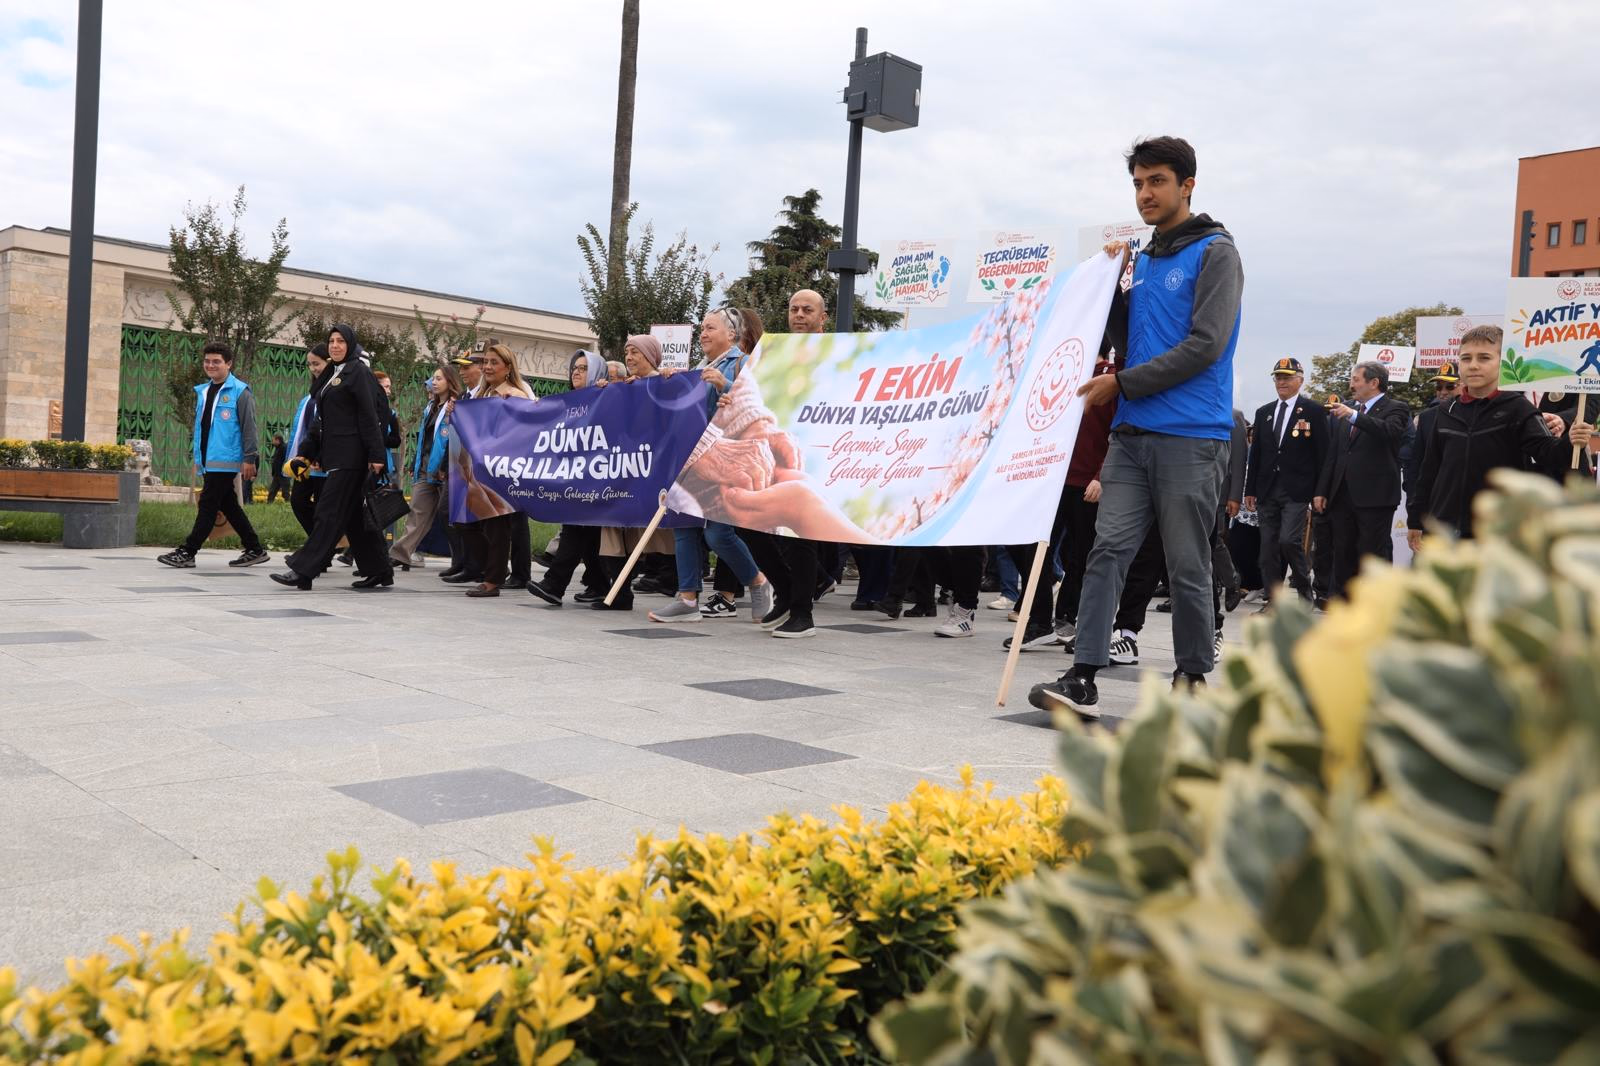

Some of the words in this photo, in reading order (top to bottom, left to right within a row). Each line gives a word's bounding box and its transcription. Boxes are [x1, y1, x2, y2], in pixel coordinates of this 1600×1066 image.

[892, 254, 913, 268] ADIM
[914, 250, 934, 262] ADIM
[983, 243, 1050, 265] TECRÜBEMİZ
[894, 262, 929, 278] SAĞLIĞA,
[977, 258, 1049, 279] DEĞERİMİZDİR!
[889, 276, 910, 288] ADIM
[910, 273, 929, 284] ADIM
[894, 282, 928, 298] HAYATA!
[1529, 302, 1587, 327] AKTİF
[1420, 348, 1451, 356] HUZUREVİ
[853, 367, 876, 402] 1
[873, 352, 963, 402] EKİM
[797, 401, 856, 425] DÜNYA
[859, 400, 938, 430] YAŞLILAR
[938, 384, 991, 419] GÜNÜ
[533, 422, 609, 453] DÜNYA
[827, 430, 885, 460] Geçmişe
[885, 428, 928, 460] Saygı
[483, 454, 587, 486] YAŞLILAR
[588, 443, 653, 480] GÜNÜ
[825, 457, 883, 488] Geleceğe
[878, 456, 925, 488] Güven
[507, 485, 534, 498] Geçmişe
[564, 486, 599, 502] Geleceğe
